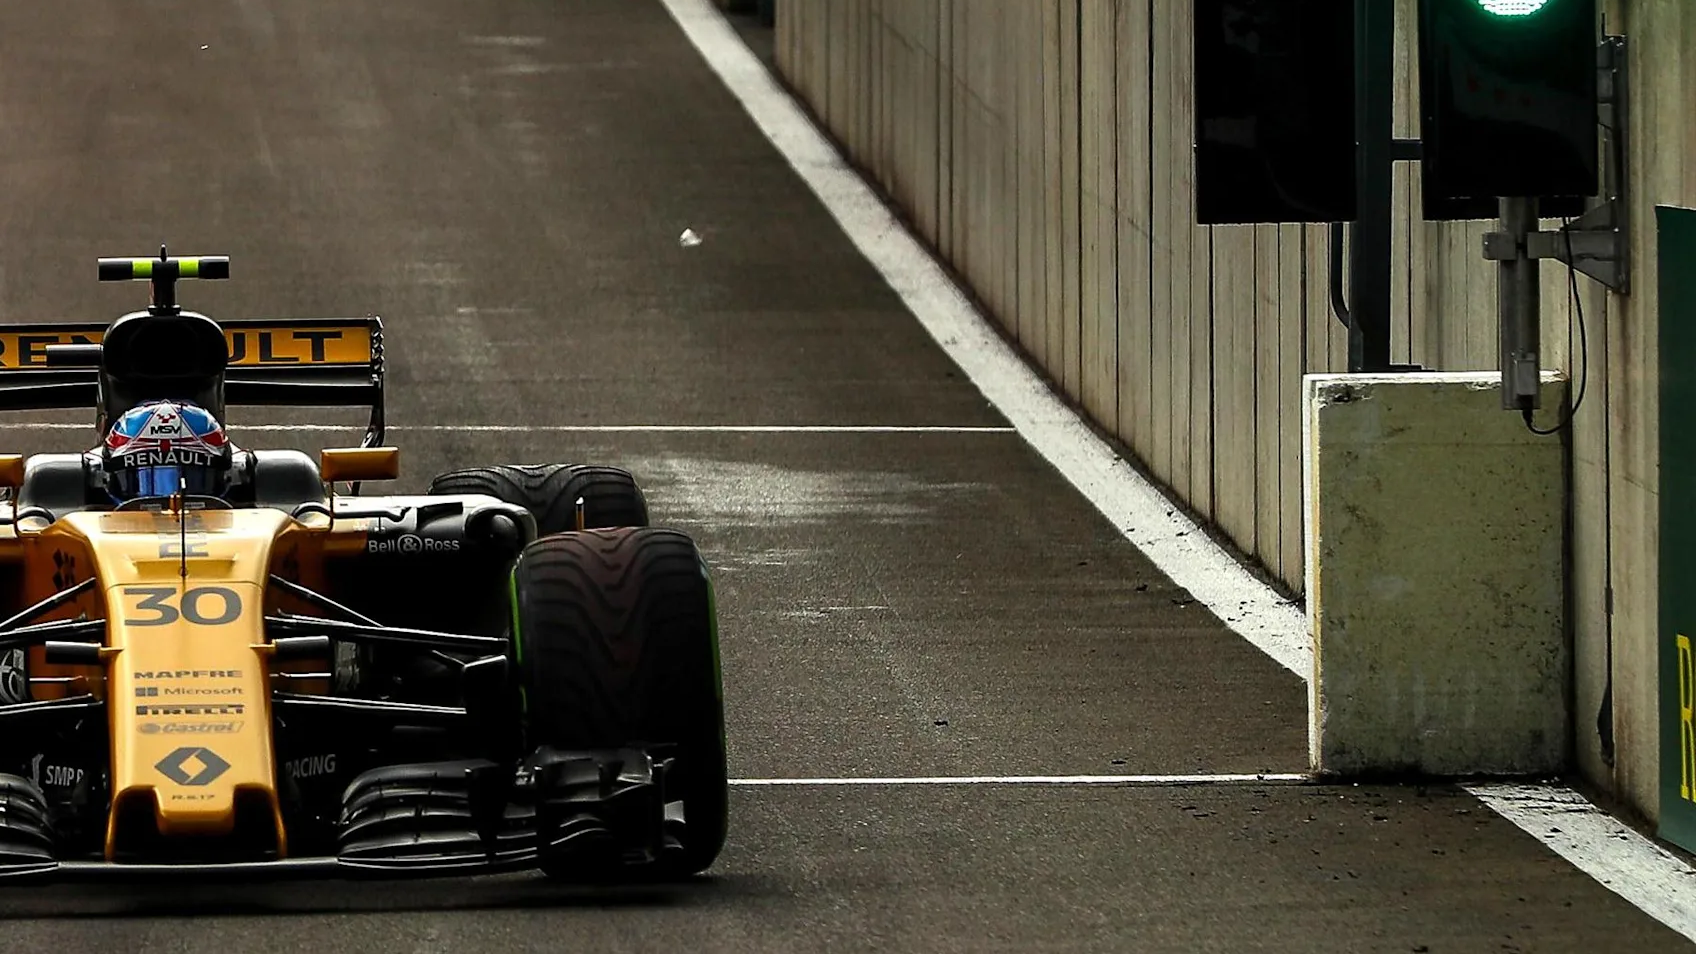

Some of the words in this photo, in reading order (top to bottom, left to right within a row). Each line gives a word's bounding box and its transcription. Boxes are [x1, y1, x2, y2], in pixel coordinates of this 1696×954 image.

[150, 425, 181, 435] MSV
[124, 451, 214, 467] RENAULT
[368, 539, 395, 553] Bell
[400, 536, 420, 553] &
[424, 538, 460, 551] Ross
[124, 587, 242, 626] 30
[134, 670, 243, 679] MAPFRE
[164, 687, 244, 695] Microsoft
[45, 765, 75, 786] SMP
